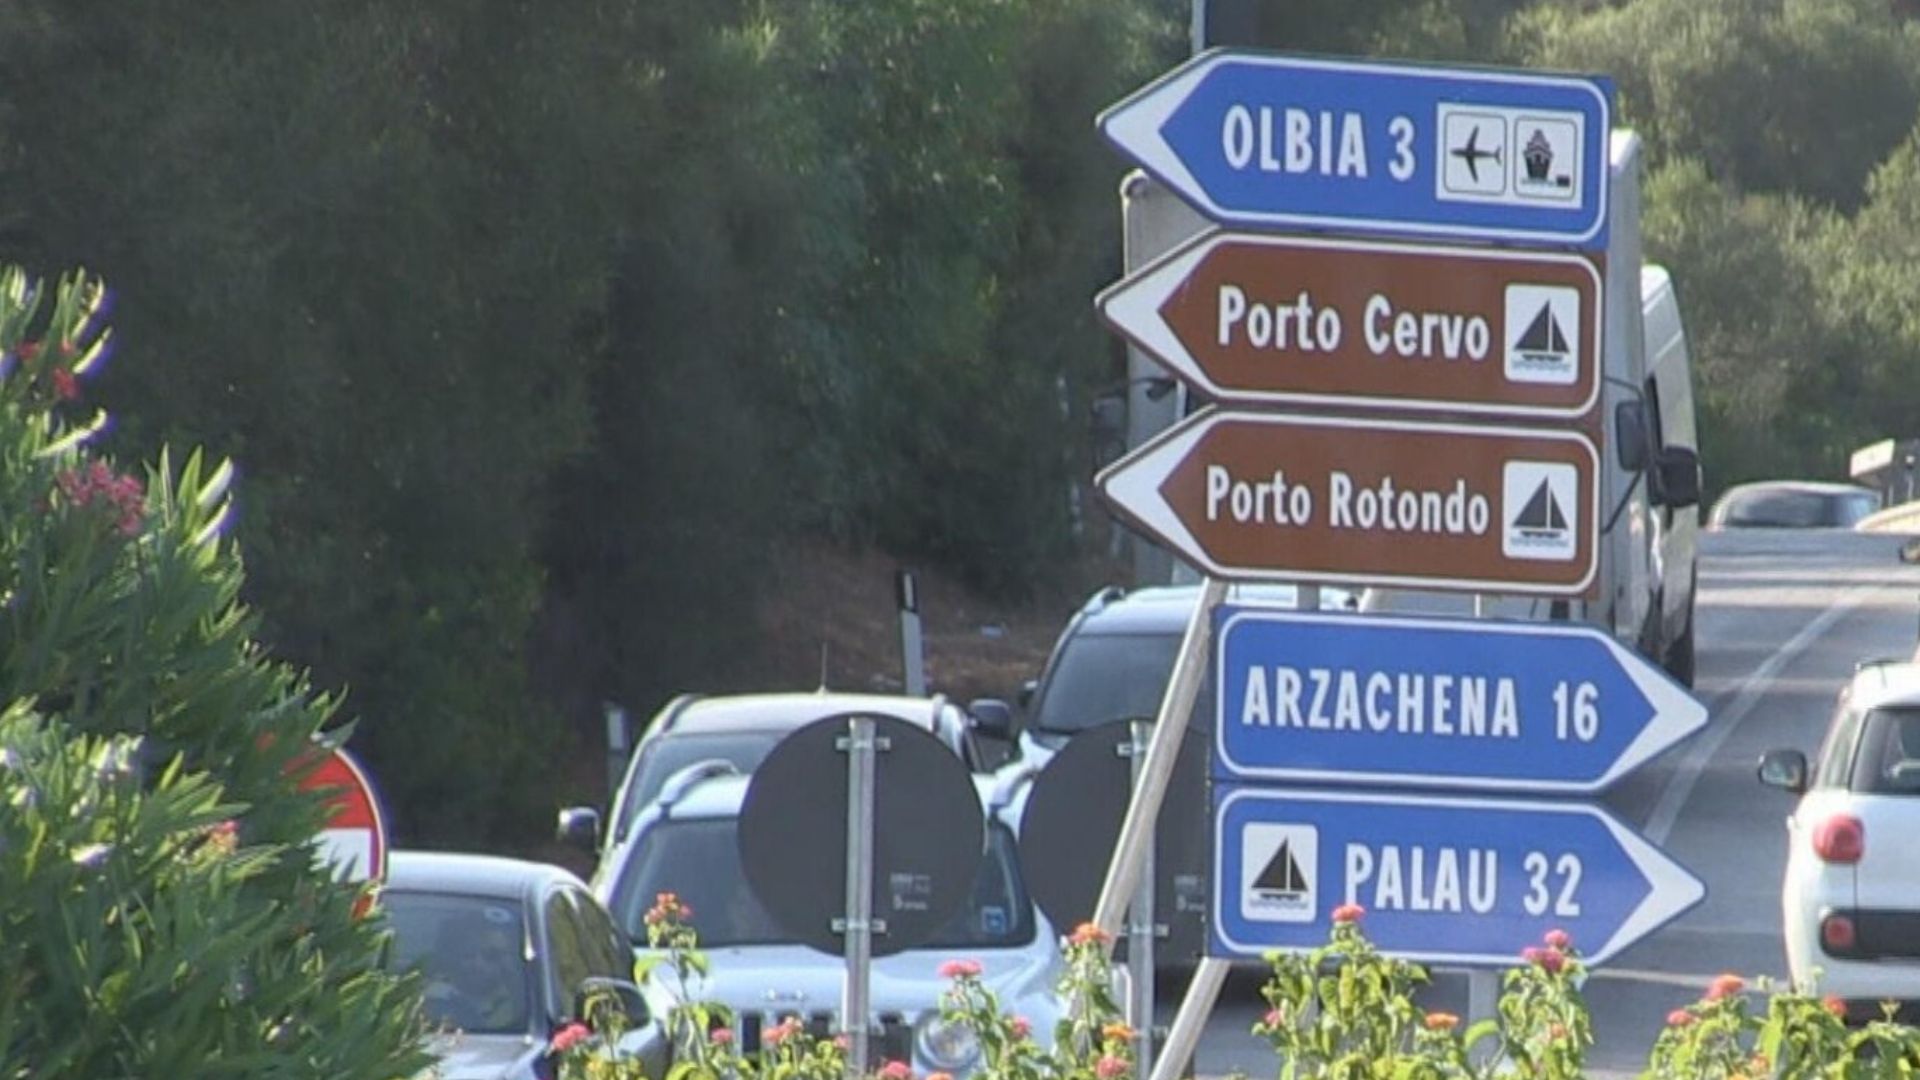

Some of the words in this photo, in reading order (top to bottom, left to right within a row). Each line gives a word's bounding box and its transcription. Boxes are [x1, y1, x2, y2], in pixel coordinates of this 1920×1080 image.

[1222, 105, 1368, 178] OLBIA
[1388, 116, 1416, 182] 3
[1218, 285, 1342, 352] Porto
[1363, 293, 1490, 360] Cervo
[1206, 465, 1311, 526] Porto
[1329, 471, 1490, 535] Rotondo
[1241, 665, 1520, 738] ARZACHENA
[1552, 681, 1599, 742] 16
[1345, 843, 1497, 914] PALAU
[1522, 851, 1582, 917] 32
